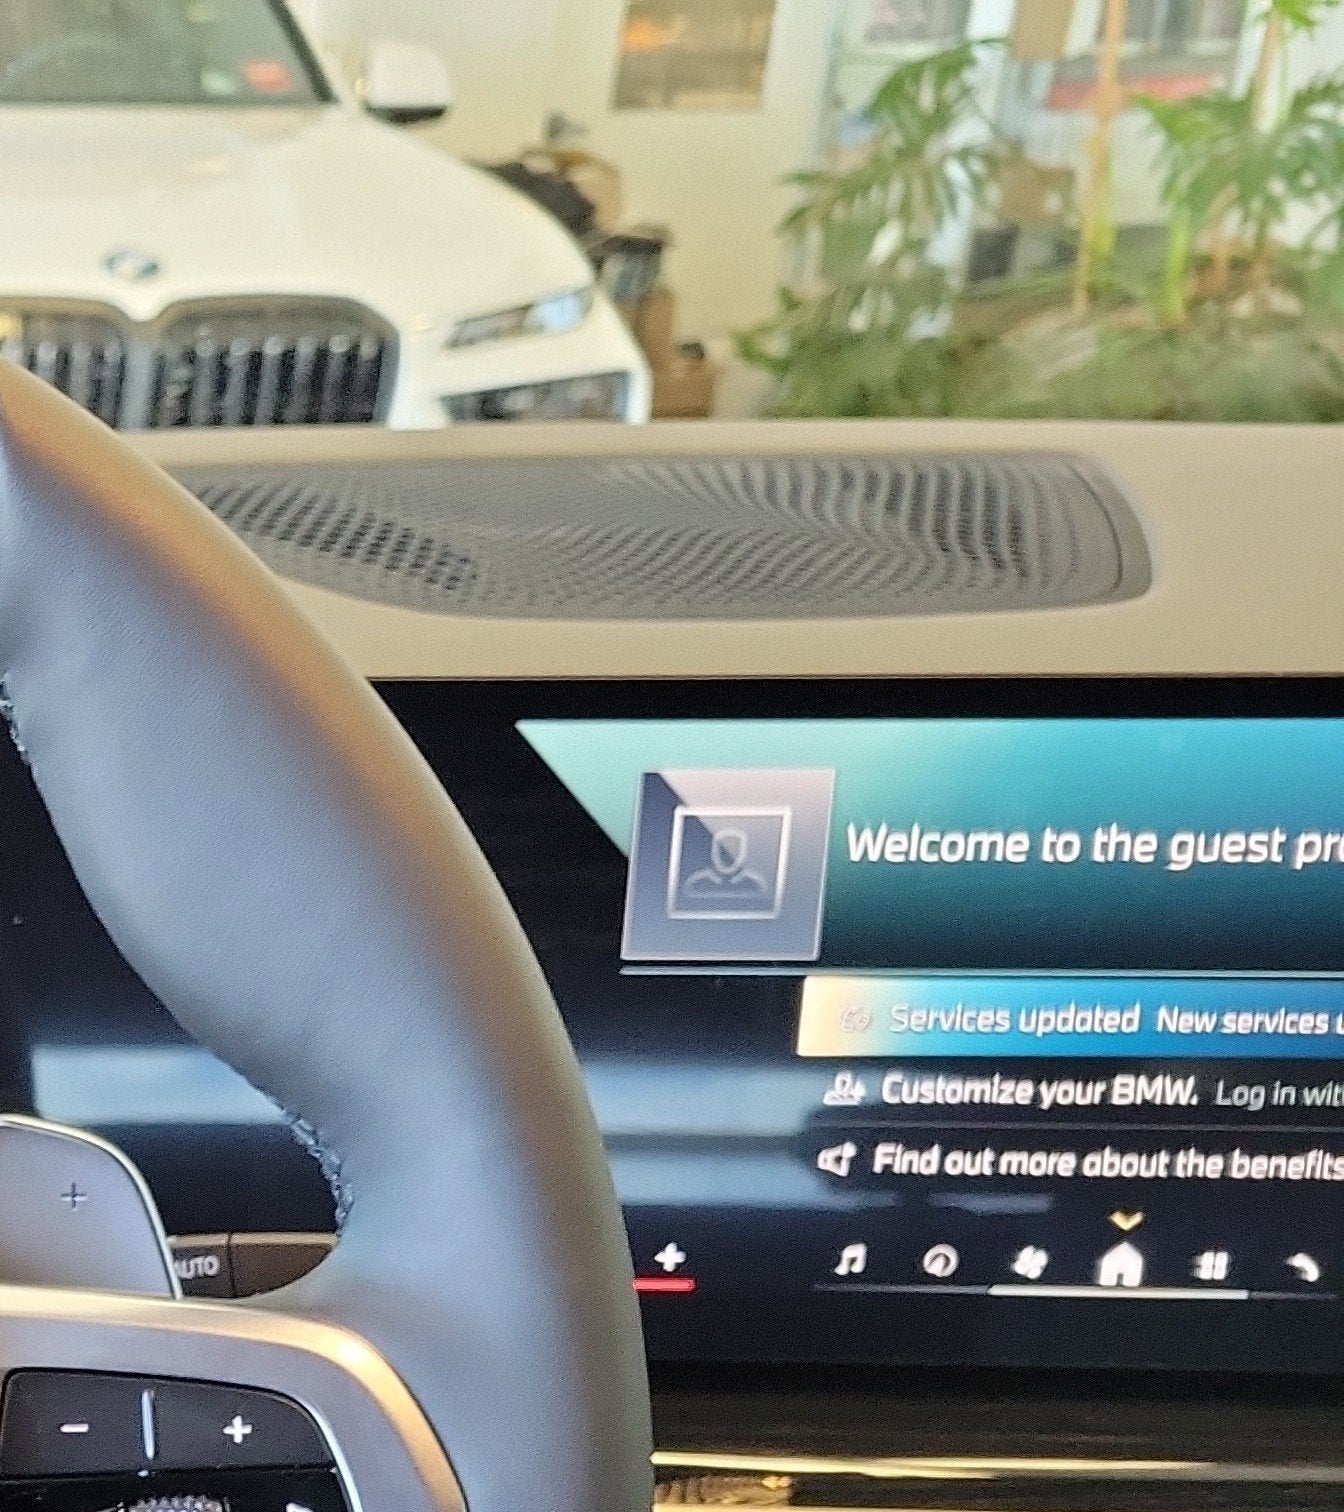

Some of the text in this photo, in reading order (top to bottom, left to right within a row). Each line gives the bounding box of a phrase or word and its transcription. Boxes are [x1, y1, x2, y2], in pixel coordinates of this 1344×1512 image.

[847, 821, 1344, 871] Welcome to the guest pr
[889, 1003, 1011, 1034] Services
[1018, 1001, 1141, 1037] updated
[1157, 1005, 1217, 1034] New
[1220, 1006, 1329, 1035] services
[882, 1071, 1344, 1111] Customize your BMW. Log in wit
[872, 1142, 1344, 1181] Find out more about the benefits
